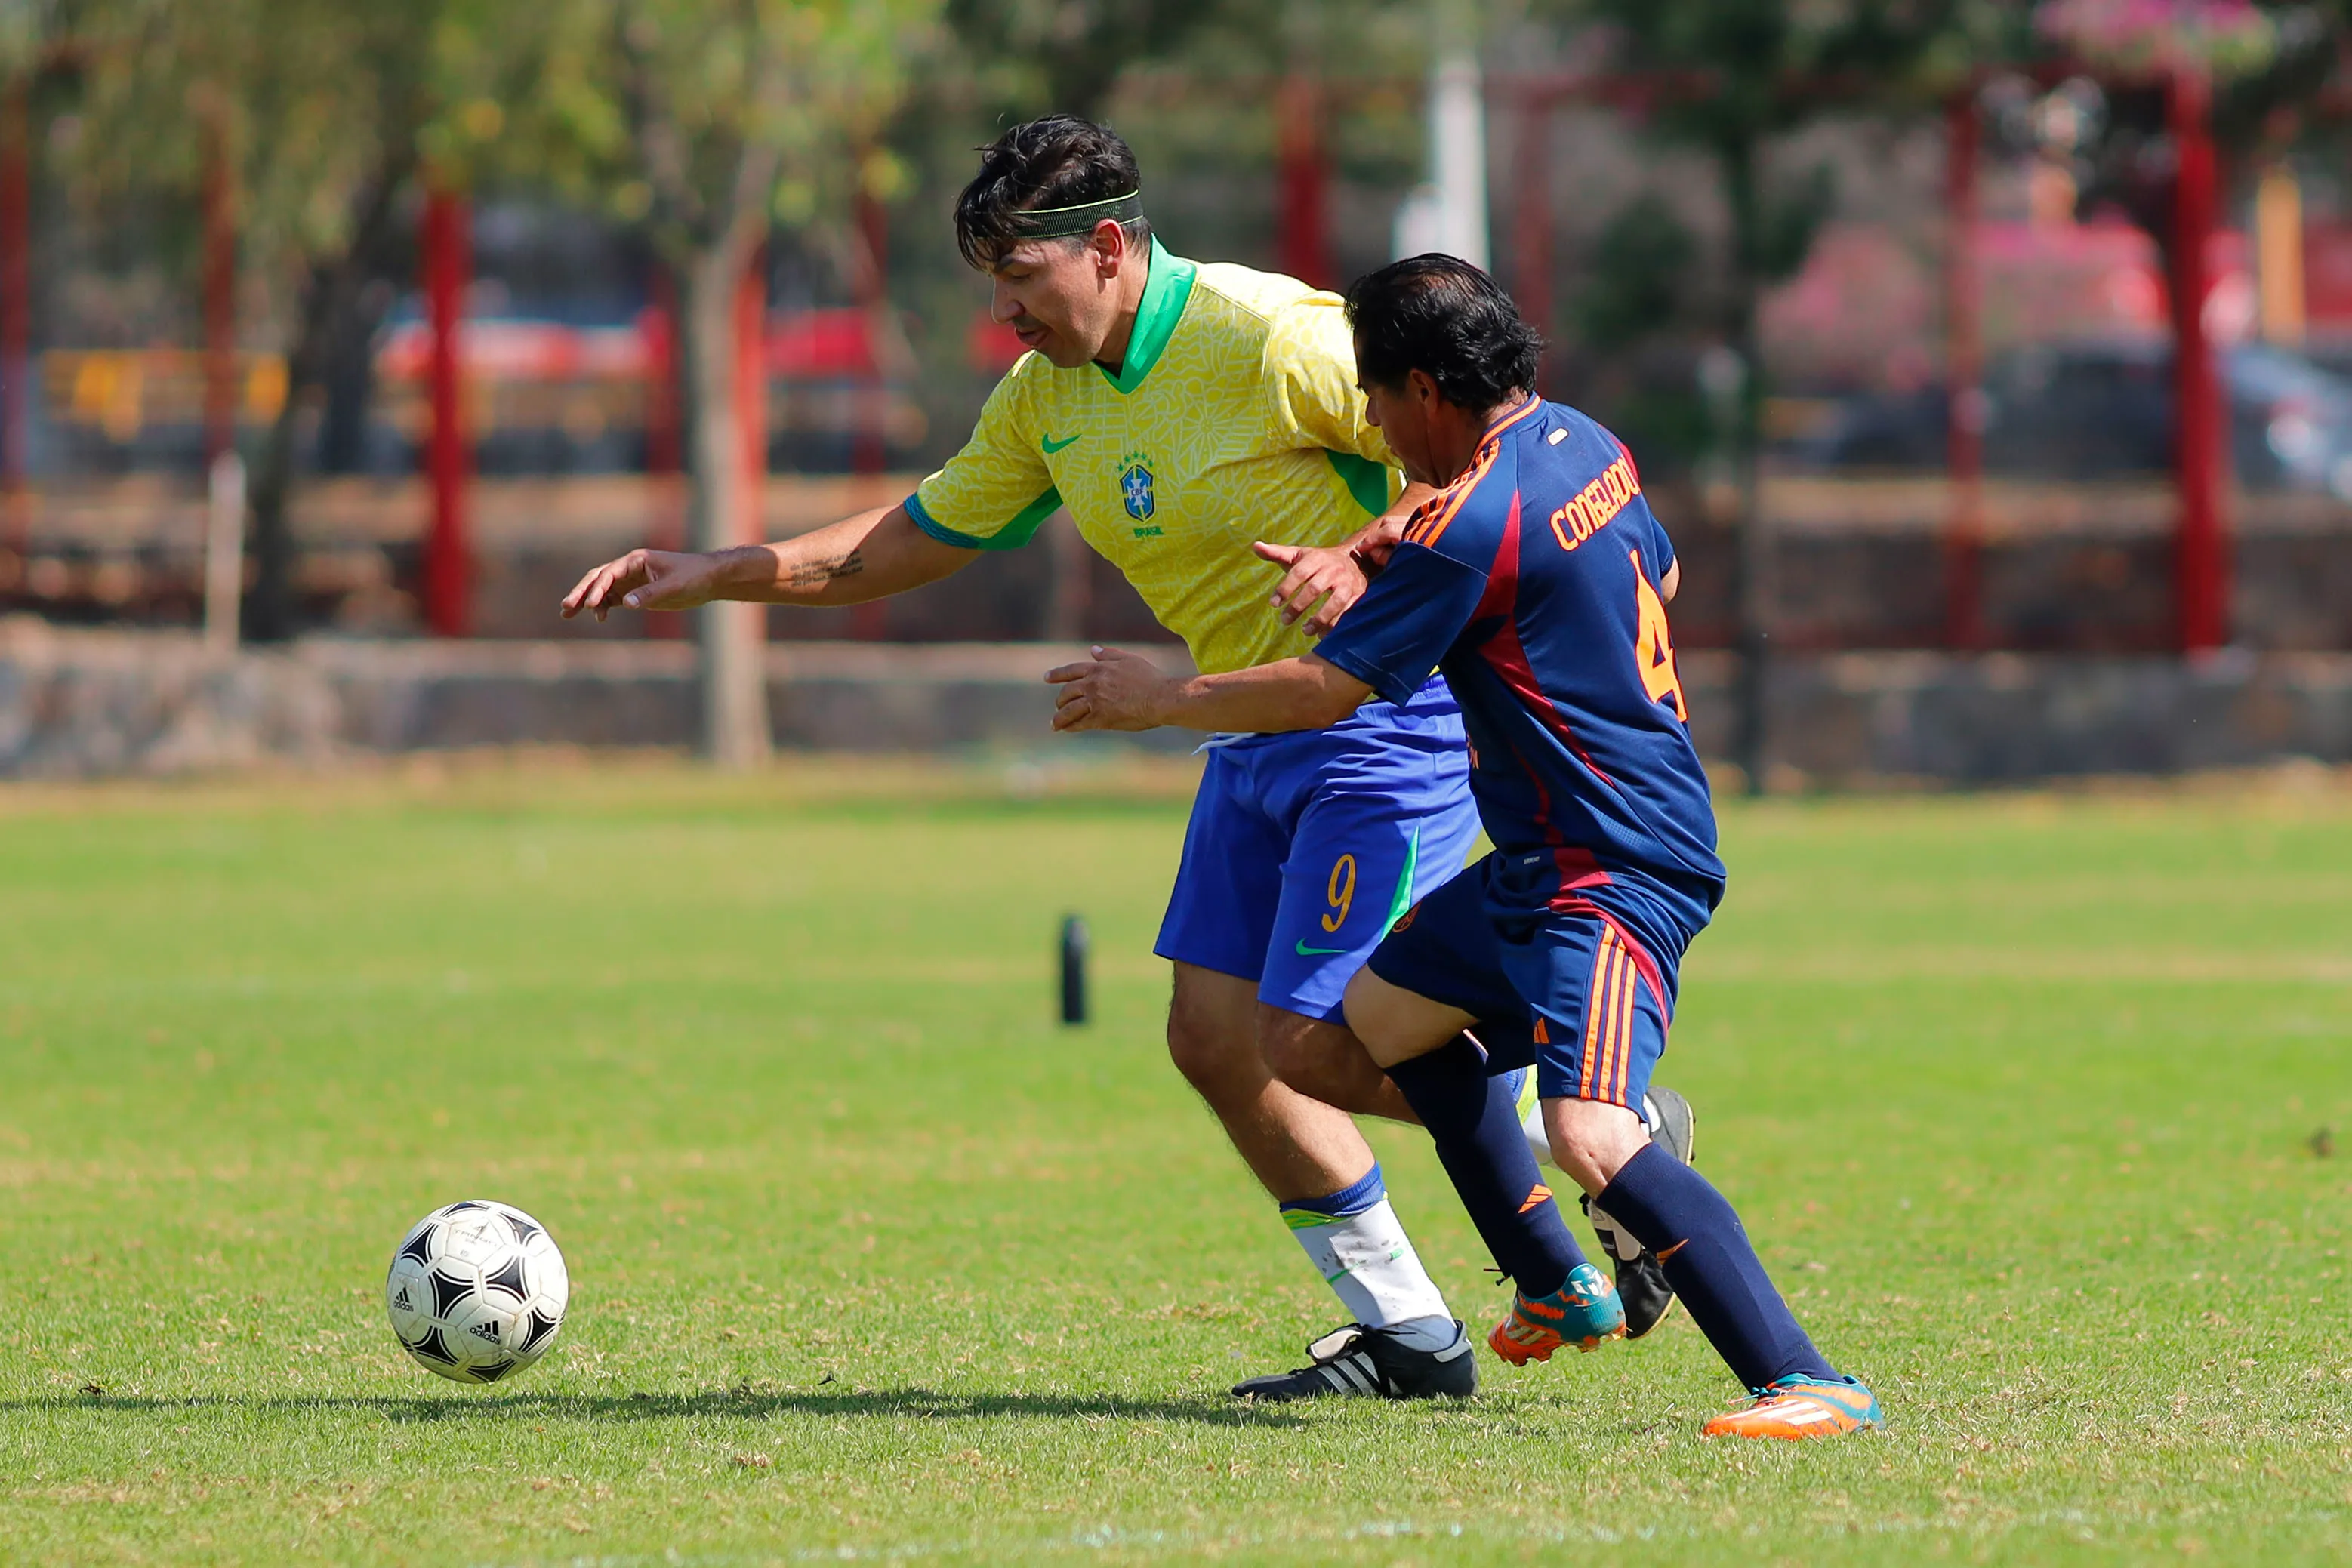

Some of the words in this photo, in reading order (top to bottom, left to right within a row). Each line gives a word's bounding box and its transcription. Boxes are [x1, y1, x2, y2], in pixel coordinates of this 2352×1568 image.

[1629, 550, 1689, 722] 4
[1321, 854, 1357, 932] 9
[393, 1300, 414, 1312] adidas
[470, 1326, 501, 1345] adidas
